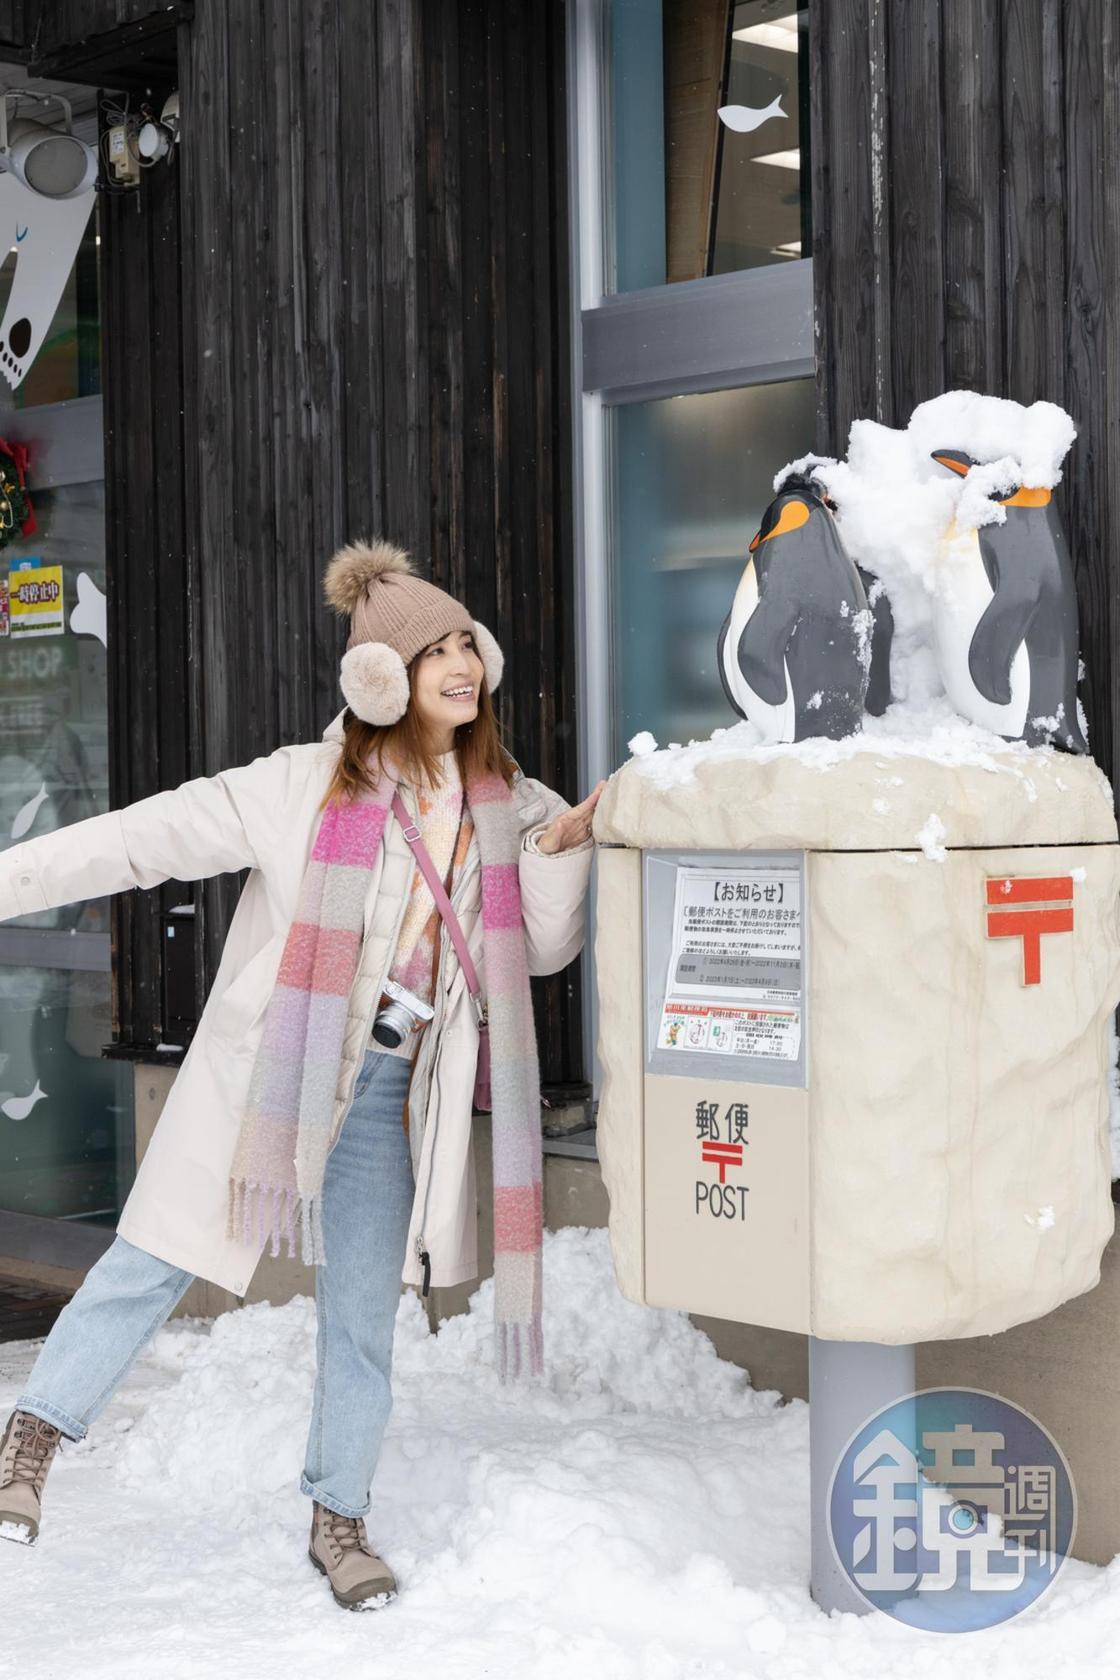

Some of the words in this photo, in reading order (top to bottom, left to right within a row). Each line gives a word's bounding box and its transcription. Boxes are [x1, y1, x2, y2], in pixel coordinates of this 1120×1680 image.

[7, 647, 63, 679] SHOP
[695, 1100, 749, 1145] 郵便
[696, 1181, 750, 1221] POST
